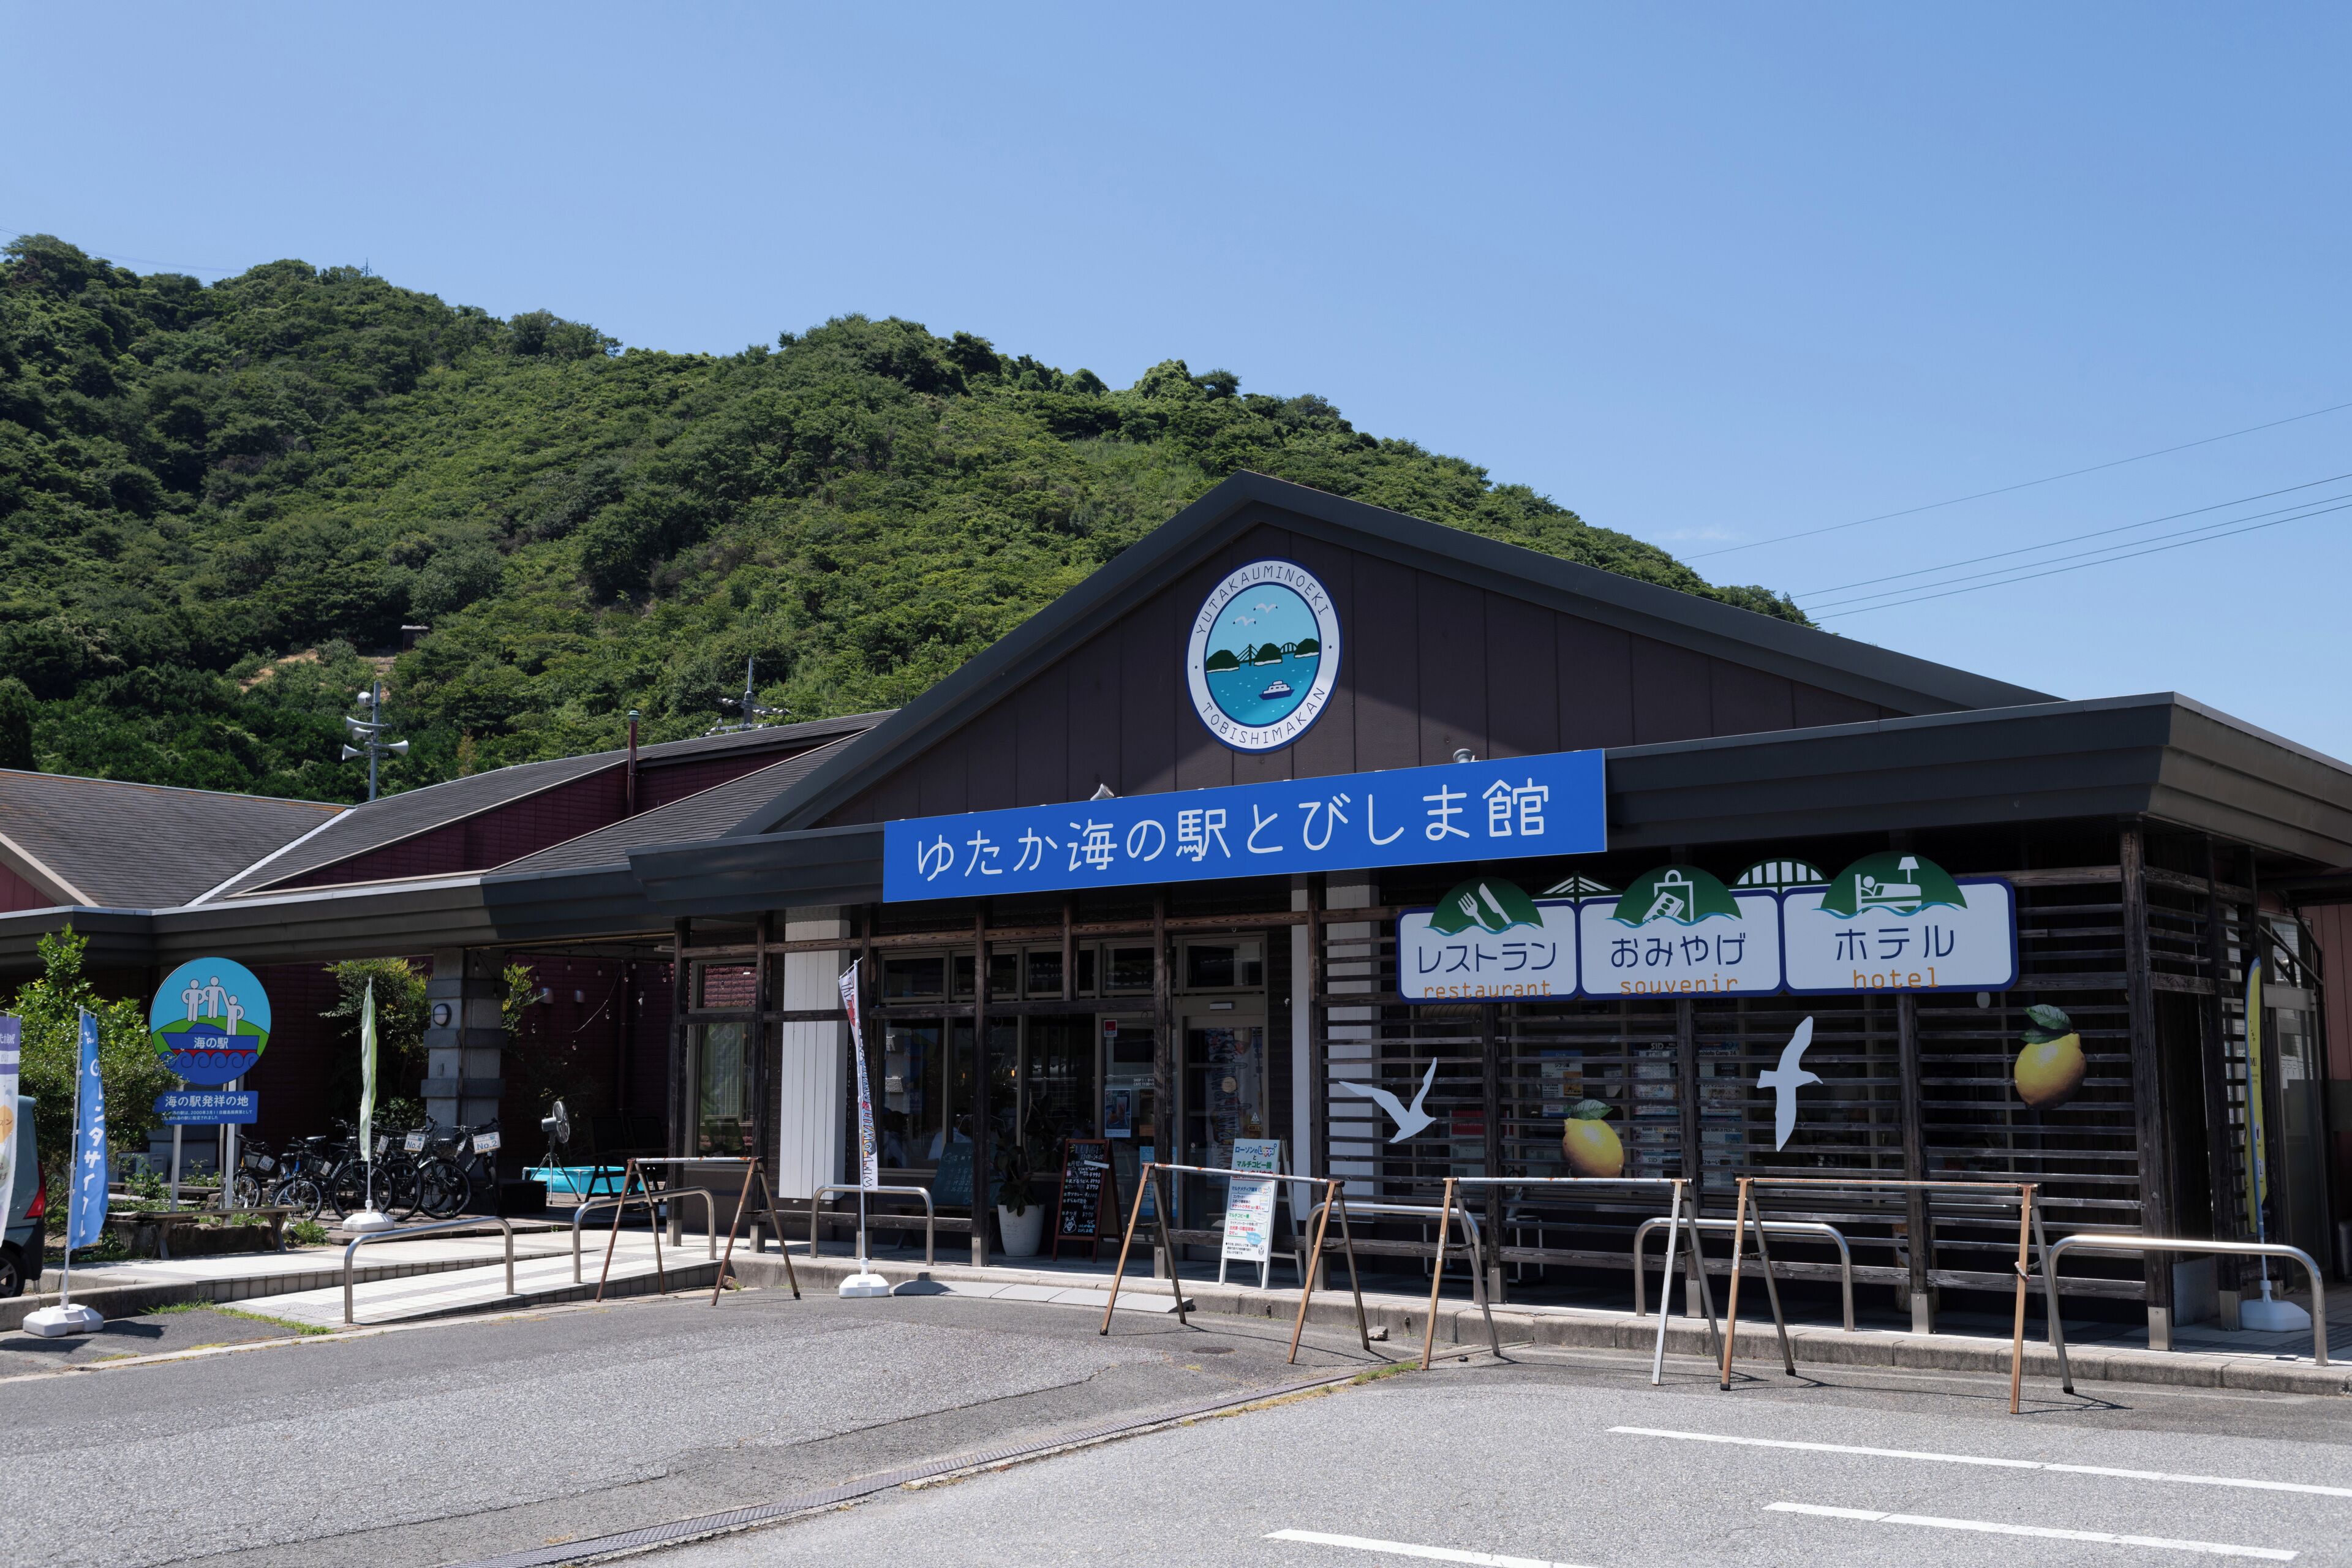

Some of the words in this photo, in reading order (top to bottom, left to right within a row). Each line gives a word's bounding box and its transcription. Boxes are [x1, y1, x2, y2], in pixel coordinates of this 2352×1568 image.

[1196, 565, 1329, 635] YUTAKAUMINOEKI
[1202, 687, 1326, 745] TOBISHIMAKAN
[916, 776, 1550, 883] ゆたか海の駅とびしま館
[1611, 932, 1746, 969] おみやげ
[1834, 924, 1956, 962] ホテル
[1418, 941, 1556, 975] レストラン
[1423, 978, 1552, 1000] restaurant
[1619, 973, 1739, 995] souvenir
[1853, 966, 1939, 990] hotel
[194, 1036, 229, 1049] 海の駅
[165, 1095, 249, 1107] 海の駅発祥の地
[407, 1140, 421, 1149] No.4
[477, 1140, 497, 1150] No.2
[1237, 1161, 1272, 1169] マルチコピー機
